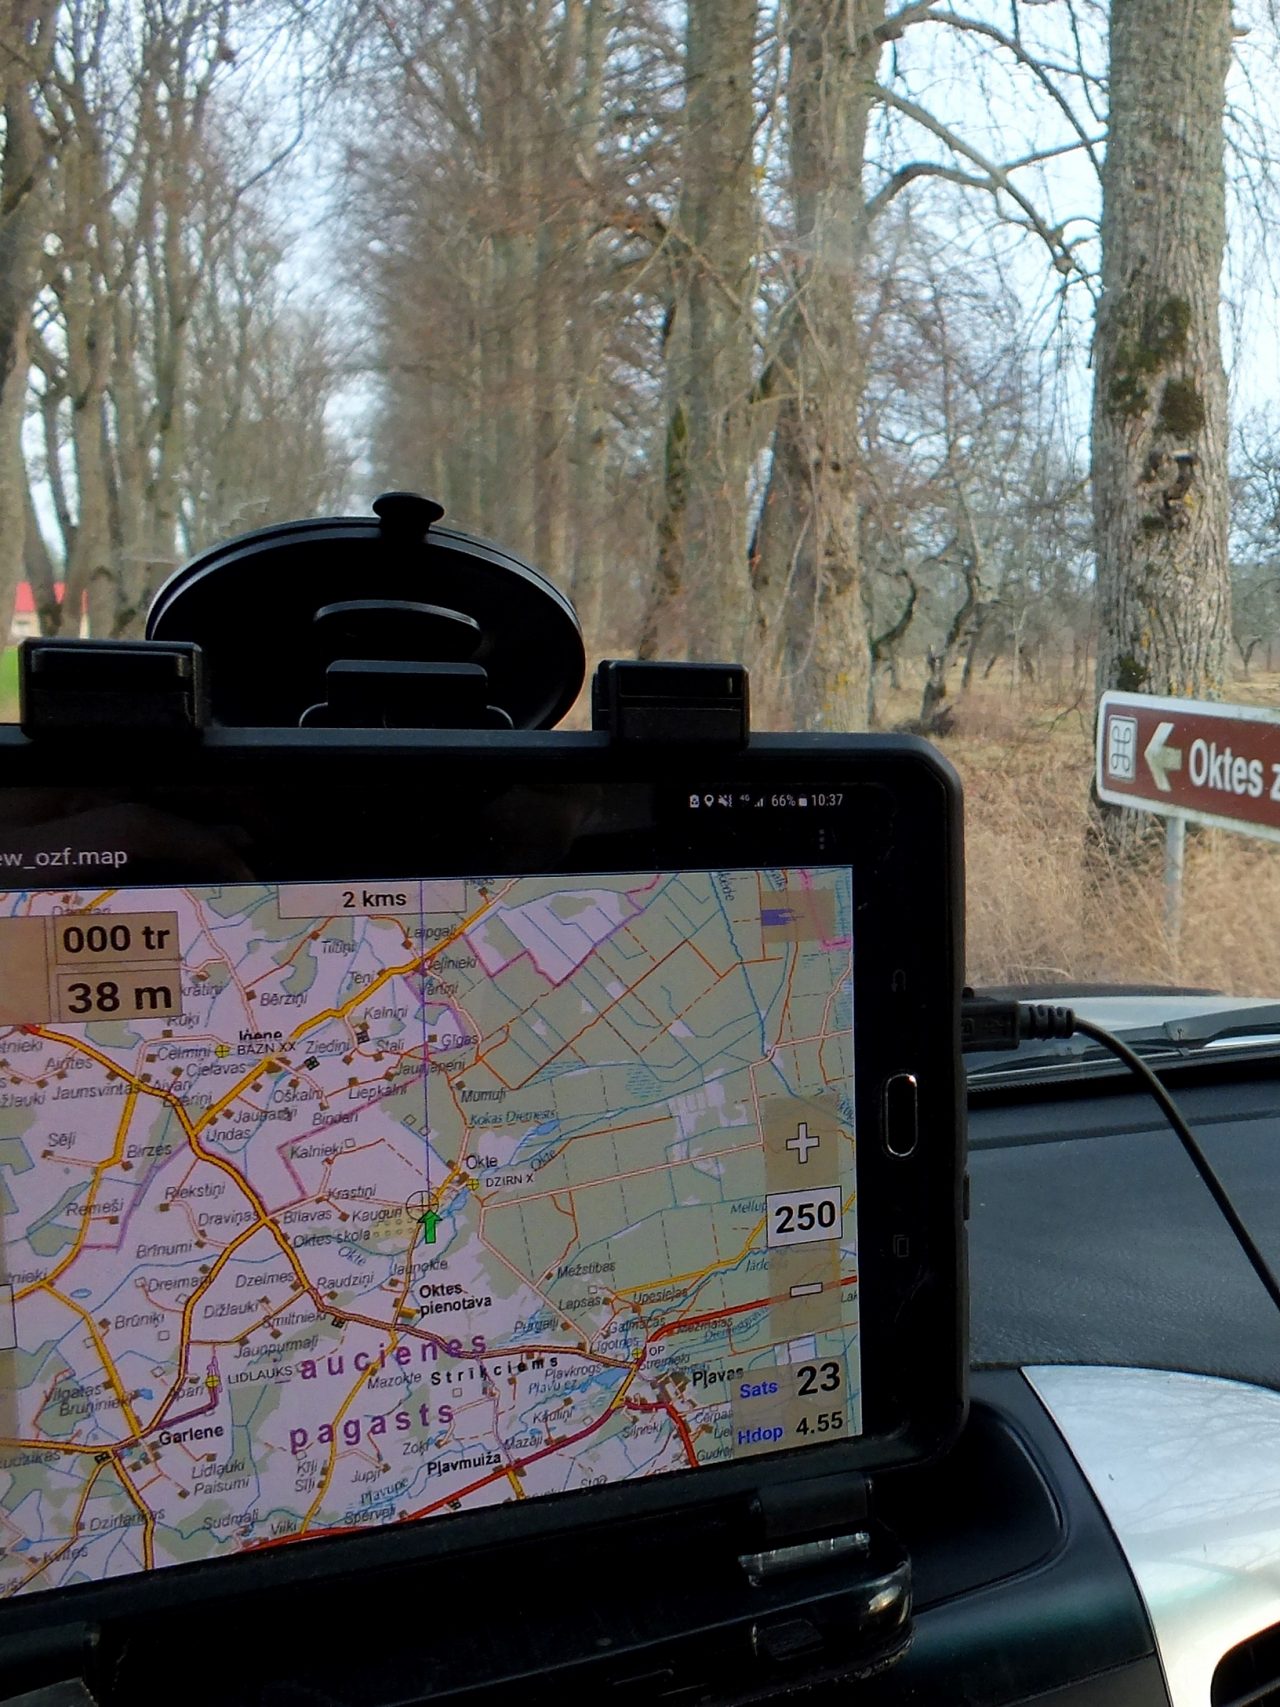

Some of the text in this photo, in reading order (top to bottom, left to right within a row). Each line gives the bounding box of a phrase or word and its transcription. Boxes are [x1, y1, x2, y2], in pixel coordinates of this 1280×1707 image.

[1188, 738, 1264, 798] Oktes
[771, 794, 797, 807] 66%
[811, 793, 844, 807] 10:37
[342, 890, 407, 908] 2 kms
[62, 923, 171, 954] 000 tr
[66, 980, 172, 1014] 38 m
[774, 1200, 836, 1234] 250
[419, 1282, 464, 1299] Oktes
[740, 1361, 841, 1399] Sats 23
[289, 1403, 455, 1456] pagasts
[737, 1411, 843, 1445] Hdop 4.55
[427, 1451, 501, 1478] Pļavmuiža
